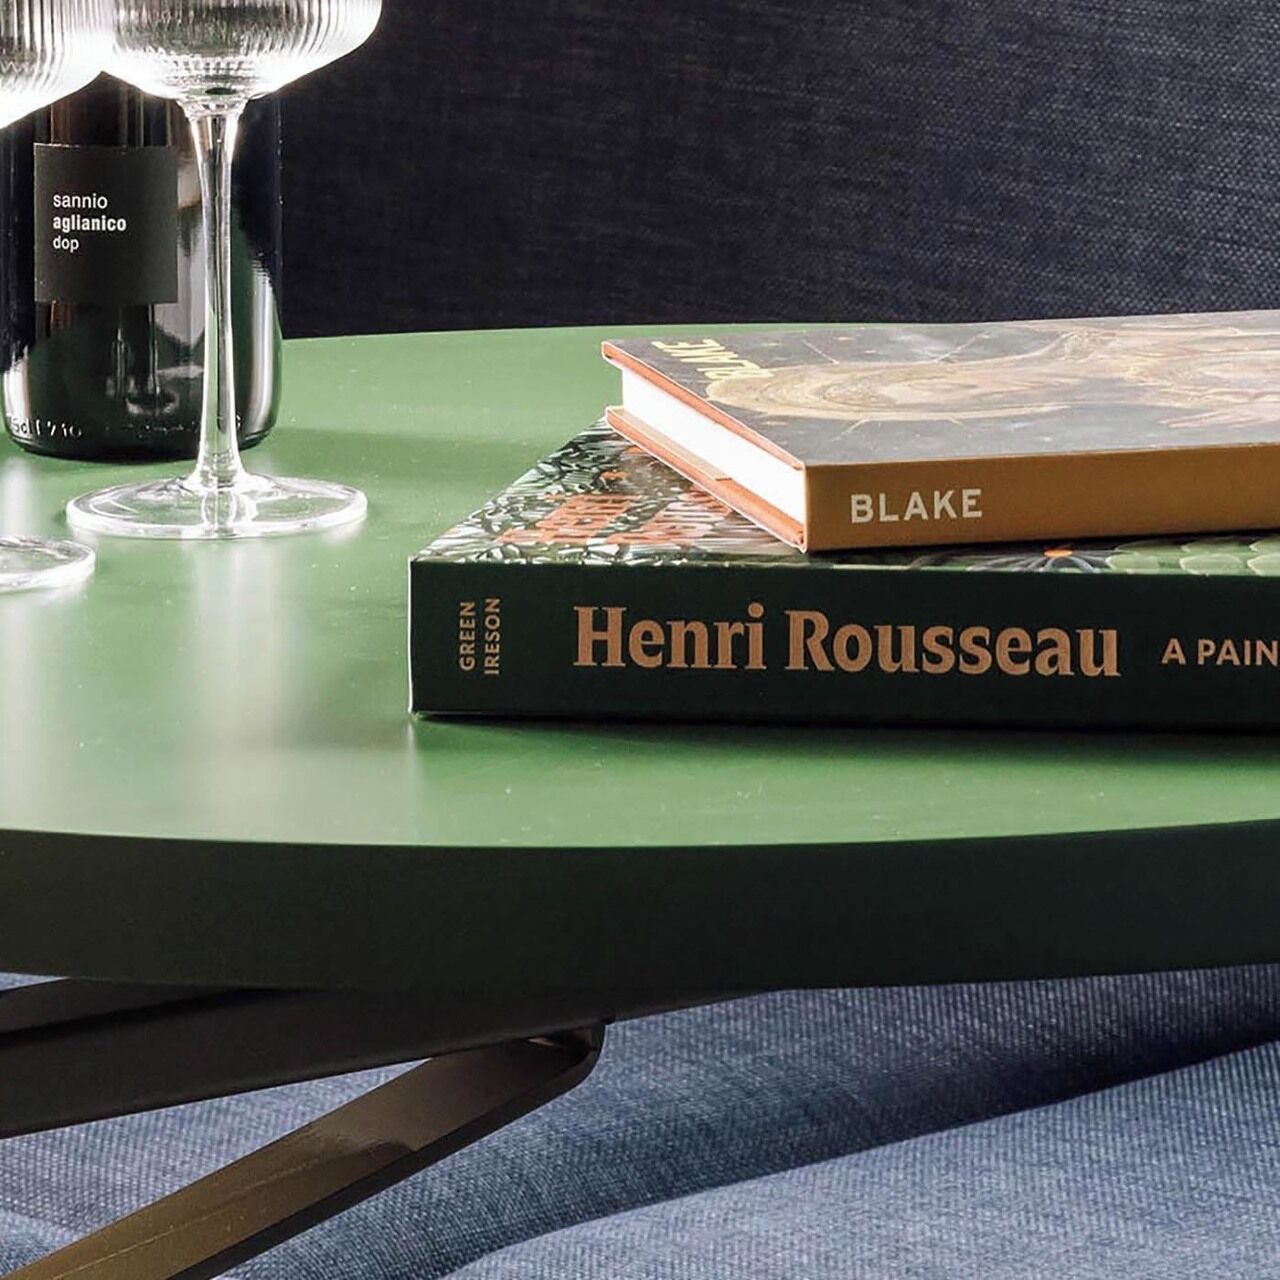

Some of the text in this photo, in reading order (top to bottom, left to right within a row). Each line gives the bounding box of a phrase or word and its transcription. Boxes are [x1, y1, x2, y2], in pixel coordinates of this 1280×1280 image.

[52, 192, 108, 209] sannio
[52, 214, 127, 234] aglianico
[52, 235, 80, 253] dop
[850, 488, 983, 524] BLAKE
[458, 601, 476, 671] GREEN
[484, 598, 501, 675] IRESON
[572, 602, 1122, 677] Henri Rousseau
[1161, 638, 1187, 665] A
